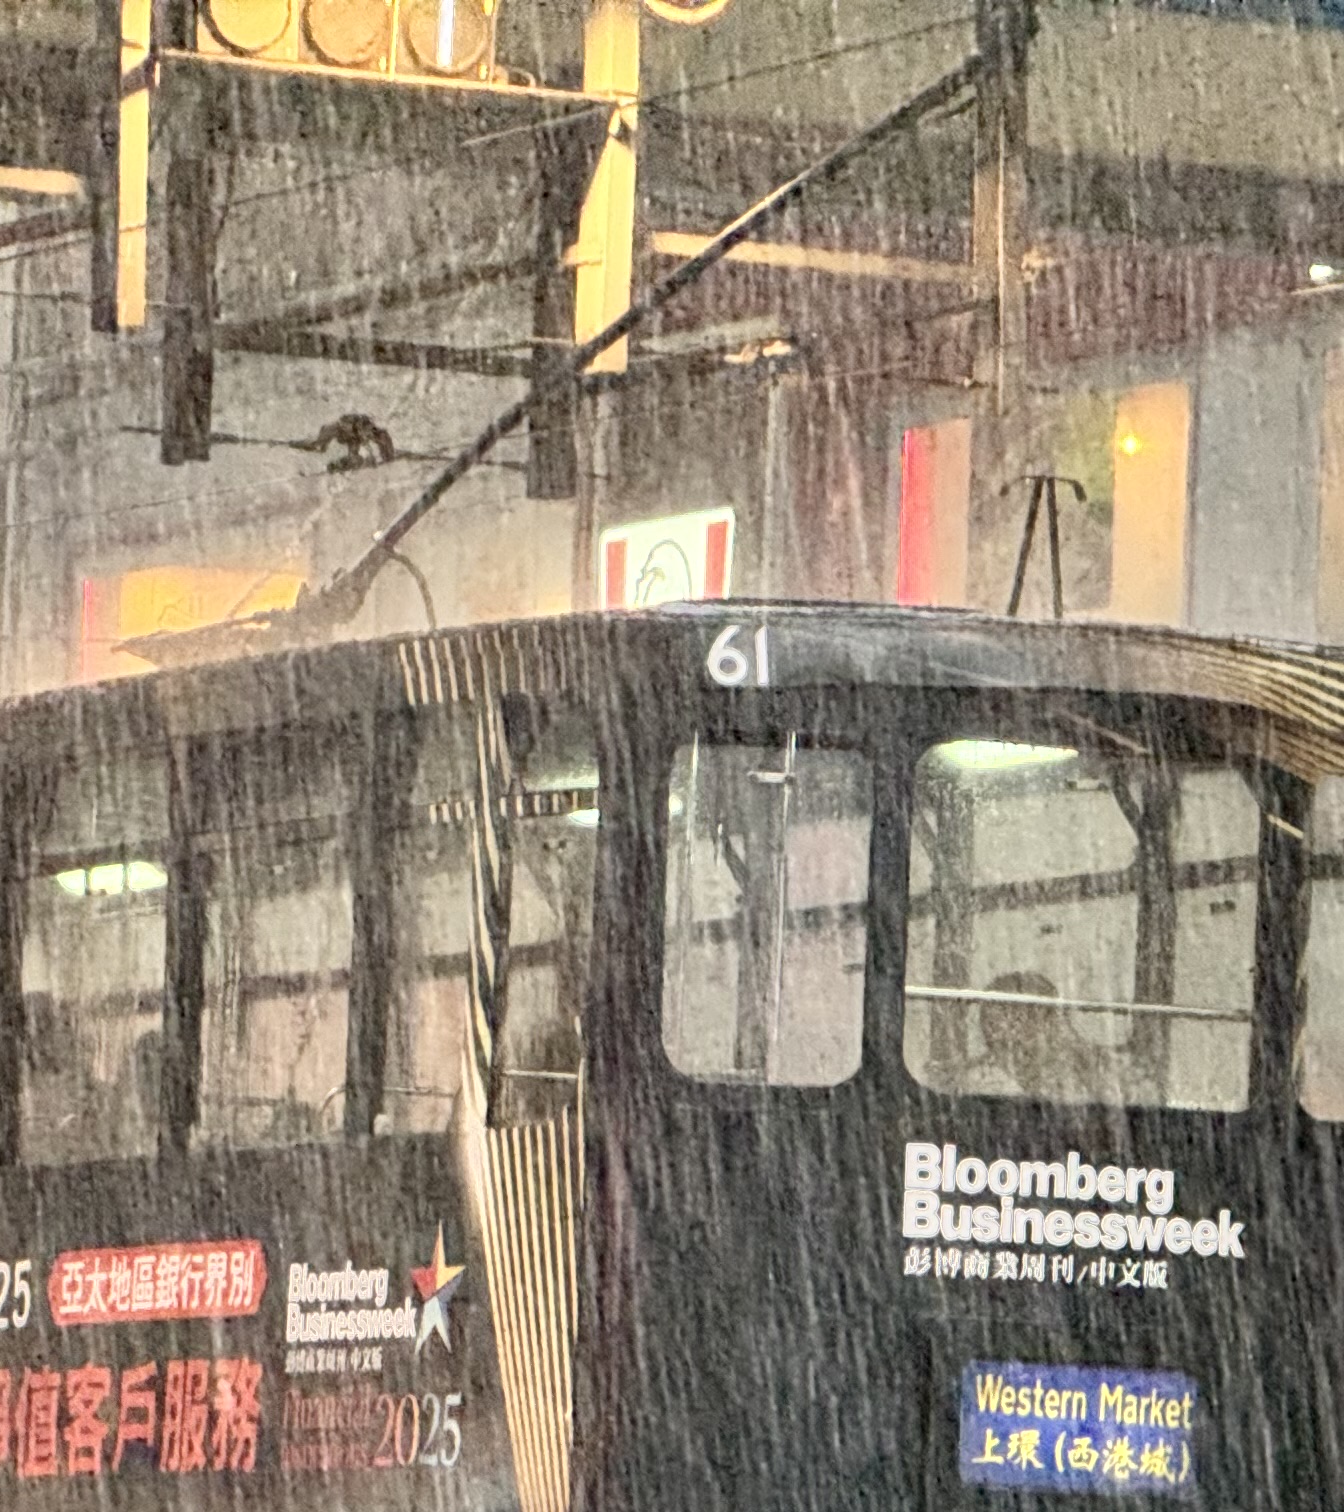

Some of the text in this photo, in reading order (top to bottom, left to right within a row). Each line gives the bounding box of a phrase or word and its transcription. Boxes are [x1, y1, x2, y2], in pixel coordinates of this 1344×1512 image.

[707, 627, 769, 687] 61
[905, 1142, 1175, 1214] Bloomberg
[902, 1189, 1247, 1259] Businessweek
[59, 1249, 255, 1317] 亞太地區銀行界別
[289, 1260, 390, 1308] Bloomberg
[286, 1296, 417, 1343] Businessweek
[370, 1391, 462, 1469] 2025
[975, 1374, 1194, 1431] Western Market
